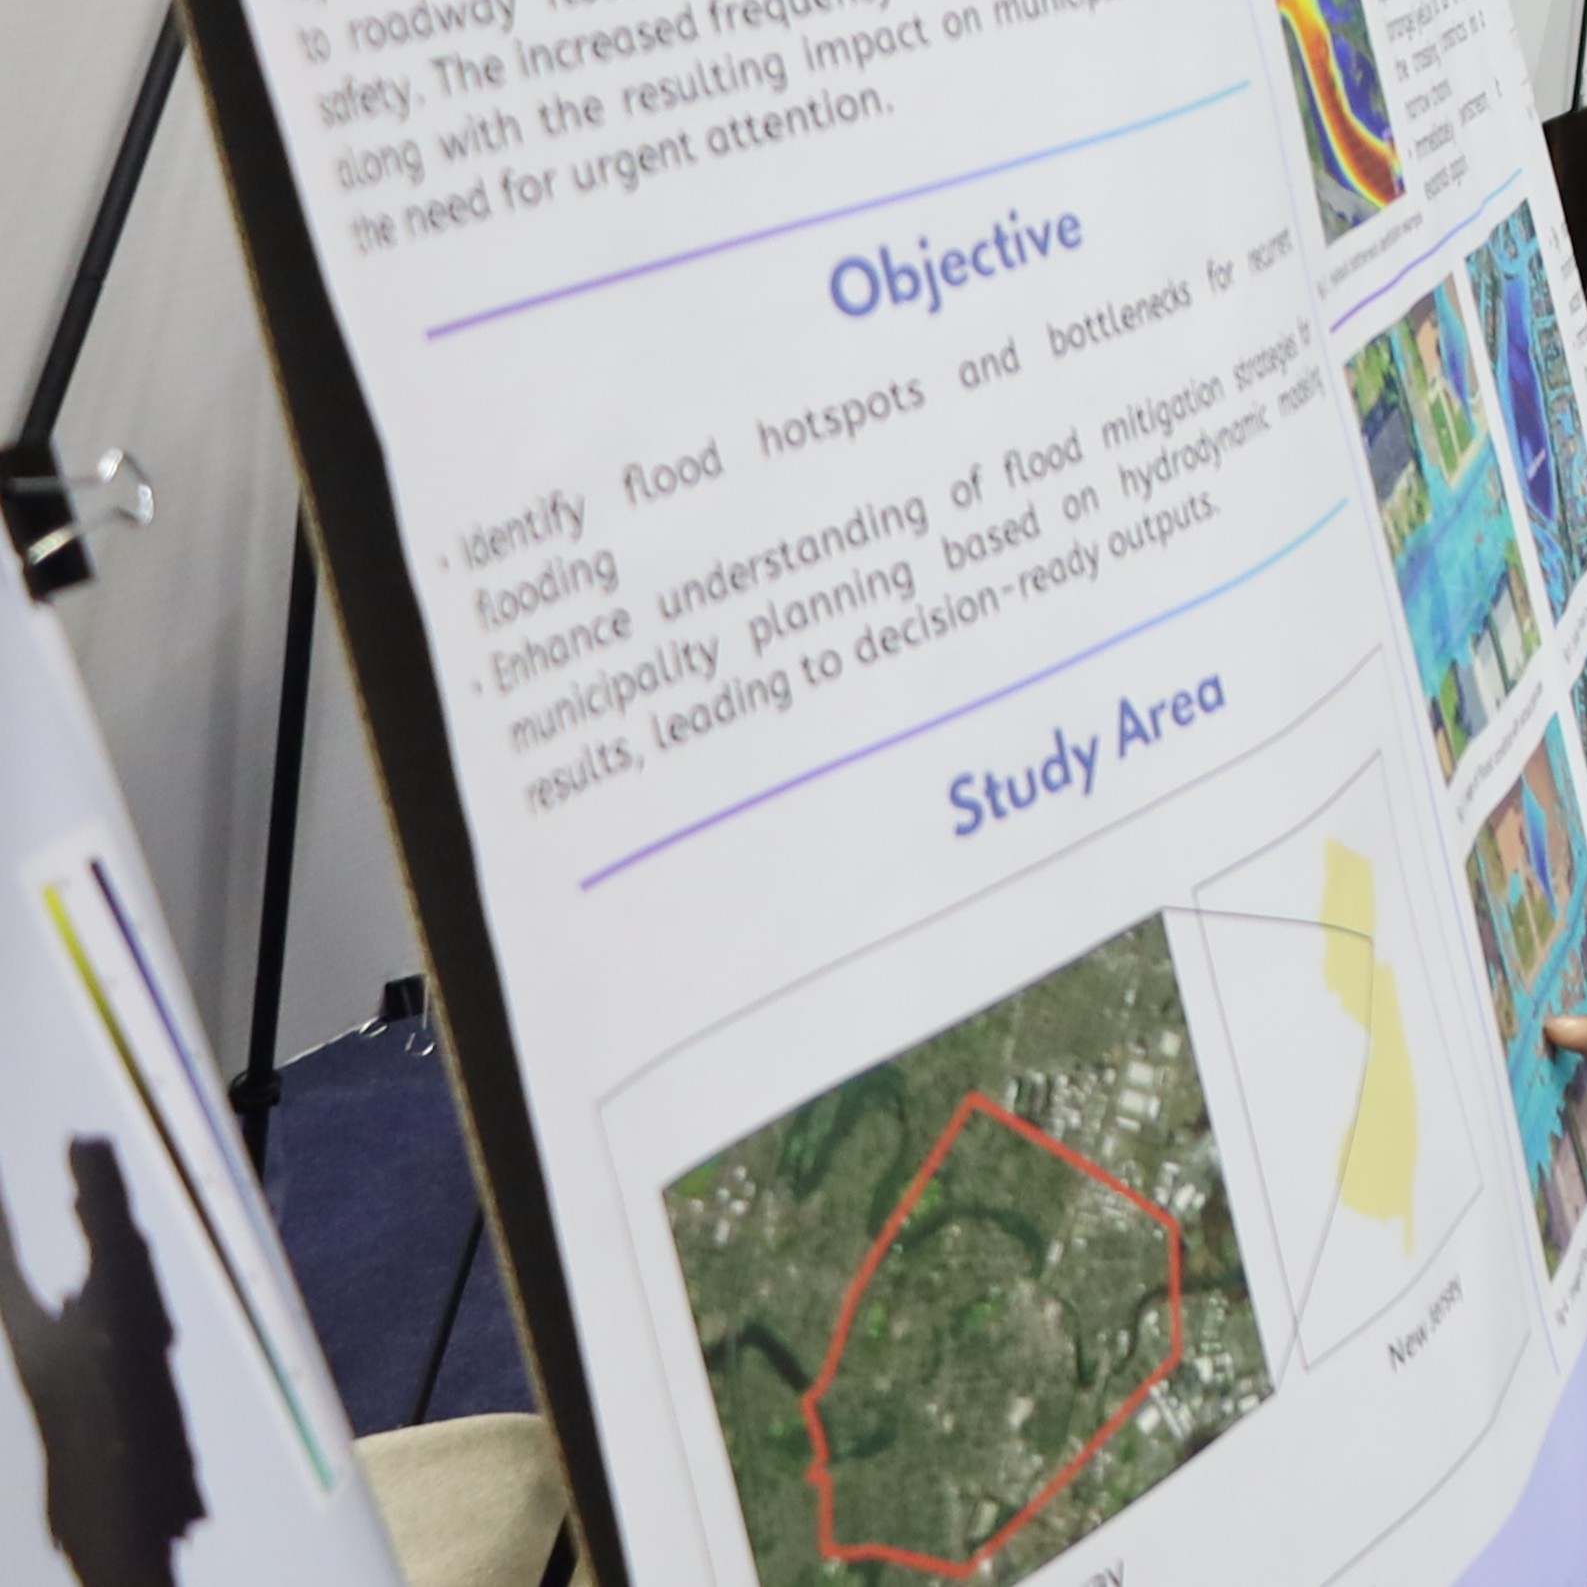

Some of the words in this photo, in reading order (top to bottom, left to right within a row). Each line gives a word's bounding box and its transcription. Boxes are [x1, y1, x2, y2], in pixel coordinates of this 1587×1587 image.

[298, 27, 331, 64] to
[318, 81, 426, 129] safety.
[432, 55, 505, 96] The
[515, 8, 700, 77] increased
[336, 140, 425, 191] along
[440, 112, 525, 163] with
[538, 93, 606, 137] the
[622, 51, 788, 114] resulting
[802, 19, 931, 73] impact
[942, 5, 983, 39] on
[351, 212, 397, 254] the
[405, 184, 492, 238] need
[501, 165, 559, 208] for
[570, 133, 698, 191] urgent
[706, 86, 895, 156] attention.
[829, 208, 1085, 319] Objective
[461, 489, 587, 569] Identify
[622, 436, 725, 507] flood
[757, 378, 925, 456] hotspots
[959, 339, 1021, 390] and
[1047, 278, 1192, 357] bottlenecks
[1206, 258, 1235, 294] for
[476, 548, 619, 631] flooding
[490, 607, 633, 696] Enhance
[656, 496, 929, 621] understanding
[950, 463, 983, 509] of
[1003, 427, 1084, 488] flood
[1101, 374, 1225, 449] mitigation
[509, 634, 719, 753] municipality
[747, 560, 916, 657] planning
[941, 502, 1041, 571] based
[1062, 485, 1100, 522] on
[1118, 404, 1271, 501] hydrodynamic
[524, 736, 645, 814] results,
[650, 668, 793, 752] leading
[800, 647, 843, 687] to
[855, 541, 1100, 666] decision-ready
[1108, 490, 1221, 558] outputs.
[948, 726, 1100, 838] Study
[1115, 672, 1227, 759] Area
[1386, 1320, 1431, 1373] New
